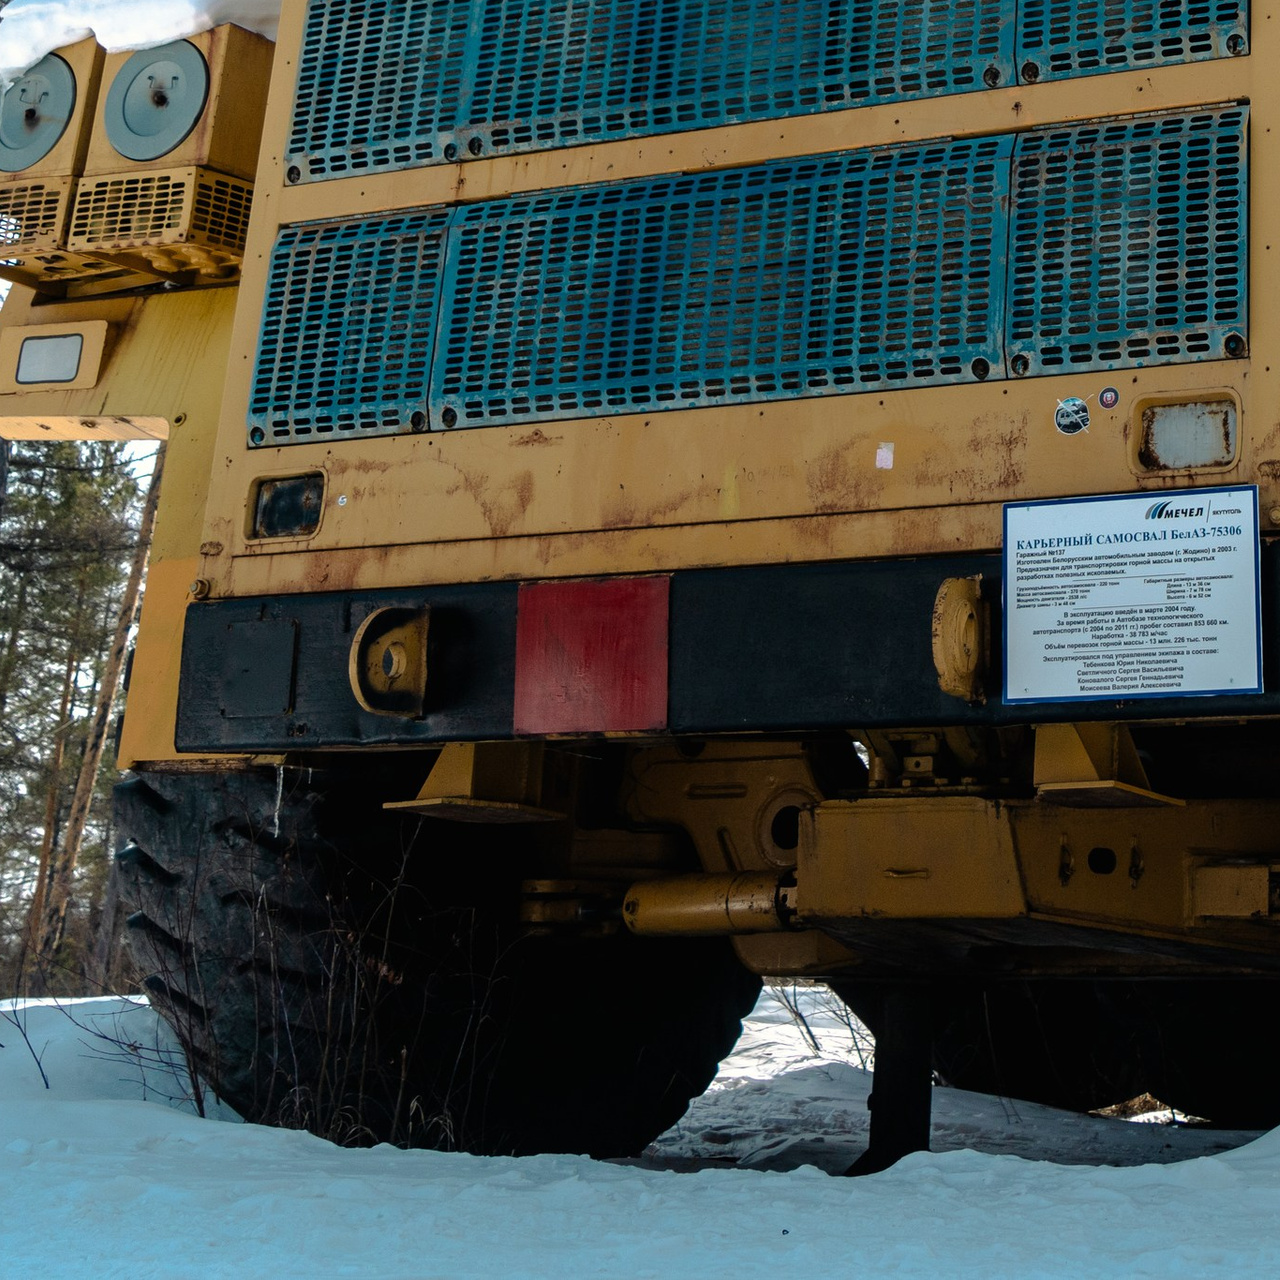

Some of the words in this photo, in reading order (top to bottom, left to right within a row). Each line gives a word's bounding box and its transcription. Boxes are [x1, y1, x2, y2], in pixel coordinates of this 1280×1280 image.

[1163, 506, 1203, 518] МЕЧЕЛ
[1016, 533, 1092, 550] КАРЬЕРНЫЙ
[1095, 529, 1167, 544] САМОСВАЛ
[1170, 524, 1241, 539] БелАЗ-75306
[1015, 549, 1047, 559] Гаражный
[1047, 548, 1065, 556] №137
[1052, 555, 1093, 563] Белорусским
[1093, 552, 1145, 560] автомобильным
[1182, 546, 1210, 555] Жодино)
[1016, 565, 1059, 574] Предназначен
[1073, 561, 1127, 570] транспортировки
[1128, 558, 1150, 566] горной
[1182, 555, 1214, 563] открытых
[1016, 572, 1053, 581] разработках
[1069, 610, 1113, 618] эксплуатацию
[1114, 607, 1137, 615] введён
[1086, 617, 1109, 625] работы
[1116, 615, 1146, 623] Автобазе
[1146, 613, 1203, 621] технологического
[1032, 627, 1081, 635] автотранспорта
[1089, 624, 1104, 632] 2004
[1129, 622, 1138, 631] гг.)
[1139, 621, 1162, 630] пробег
[1091, 632, 1124, 640] Наработка
[1099, 639, 1122, 648] горной
[1042, 654, 1100, 662] Эксплуатировался
[1114, 651, 1156, 660] управлением
[1116, 659, 1134, 667] Юрия
[1117, 667, 1140, 675] Сергея
[1141, 665, 1184, 673] Васильевича
[1138, 673, 1183, 681] Геннадьевича
